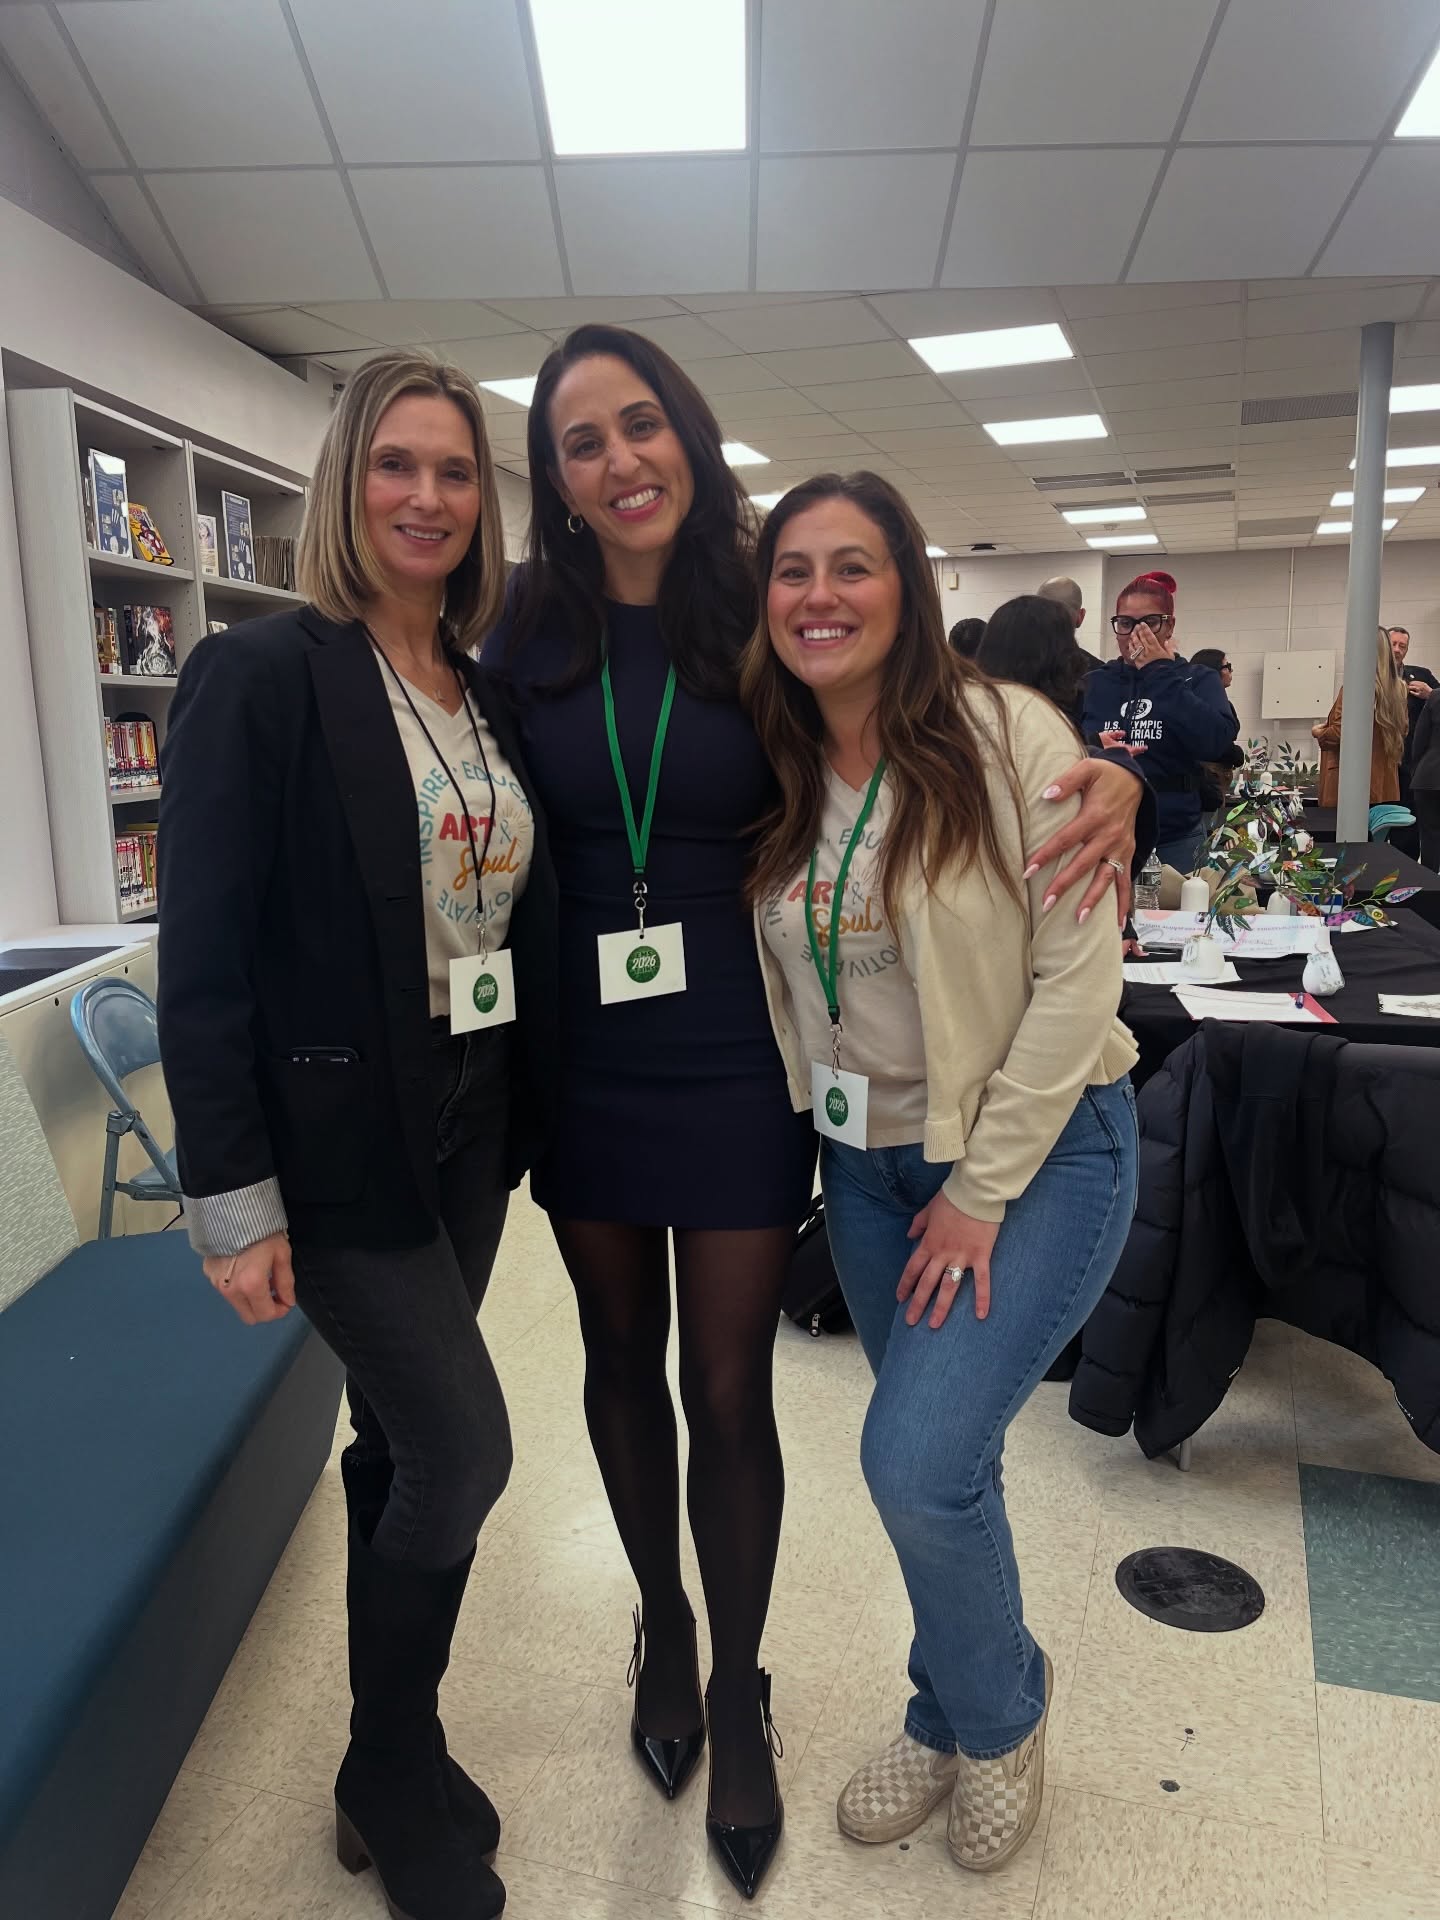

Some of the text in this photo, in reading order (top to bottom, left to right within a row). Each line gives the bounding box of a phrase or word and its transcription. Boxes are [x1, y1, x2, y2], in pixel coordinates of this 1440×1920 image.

[1104, 720, 1121, 730] U.S.
[1130, 729, 1163, 740] TRIALS
[438, 812, 512, 845] ART &
[453, 837, 520, 891] Soul
[437, 888, 512, 924] OTIVATE
[812, 896, 883, 948] Soul
[632, 954, 657, 970] 2026
[829, 1097, 846, 1112] 2026
